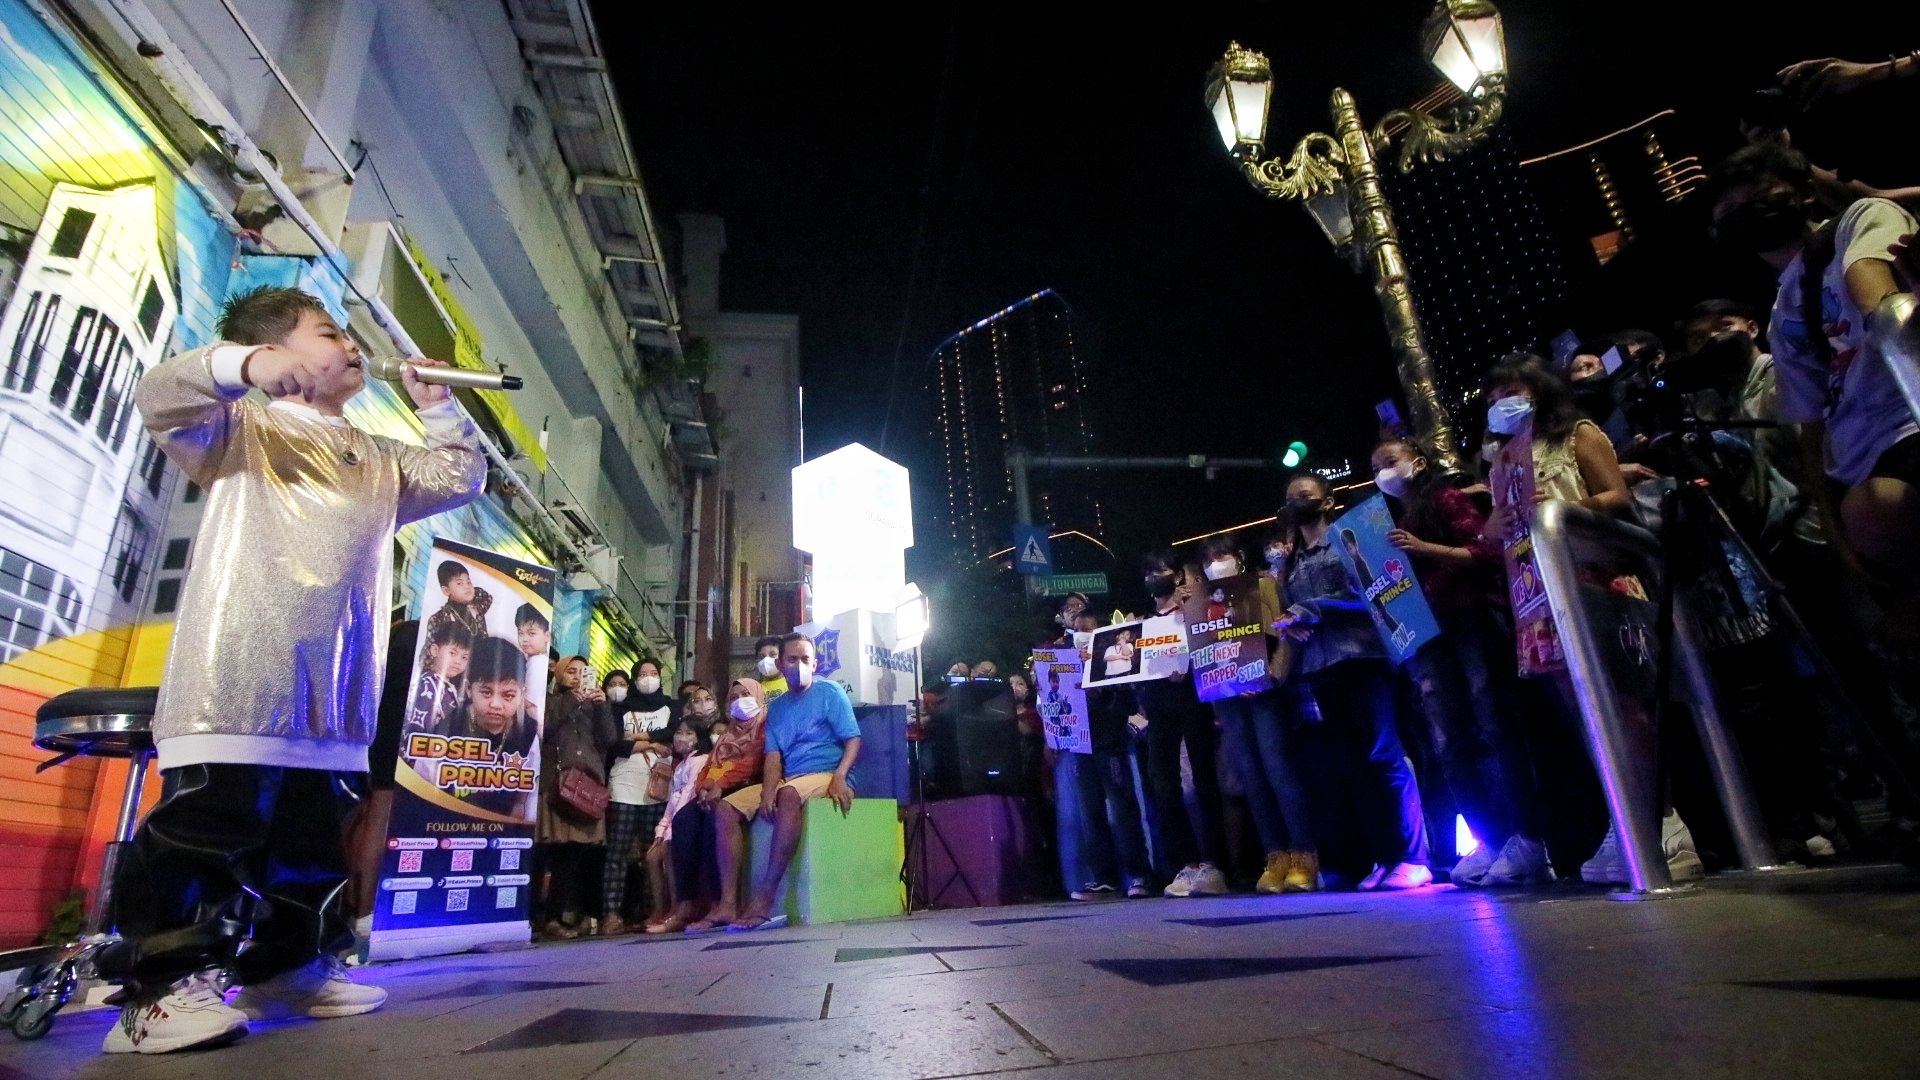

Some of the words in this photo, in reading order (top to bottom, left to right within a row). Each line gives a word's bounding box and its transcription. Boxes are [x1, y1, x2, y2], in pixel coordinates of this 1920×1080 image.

[1052, 577, 1105, 590] TUNJUNGAN
[1364, 575, 1390, 602] EDSEL
[1379, 577, 1412, 606] PRINCE
[1190, 618, 1233, 635] EDSEL
[1217, 623, 1261, 640] PRINCE
[1135, 634, 1182, 649] EDSEL
[1033, 652, 1058, 662] EDSEL
[1190, 644, 1215, 669] THE
[1214, 641, 1241, 663] NEXT
[1050, 664, 1080, 673] PRINCE
[1201, 662, 1238, 689] RAPPER
[1237, 659, 1265, 683] STAR
[1043, 702, 1060, 716] DROP
[1044, 721, 1060, 736] VOICE
[1060, 715, 1078, 726] YOUR
[409, 734, 496, 762] EDSEL
[439, 764, 535, 791] PRINCE
[426, 822, 469, 832] FOLLOW
[471, 823, 486, 832] ME
[488, 823, 504, 832] ON
